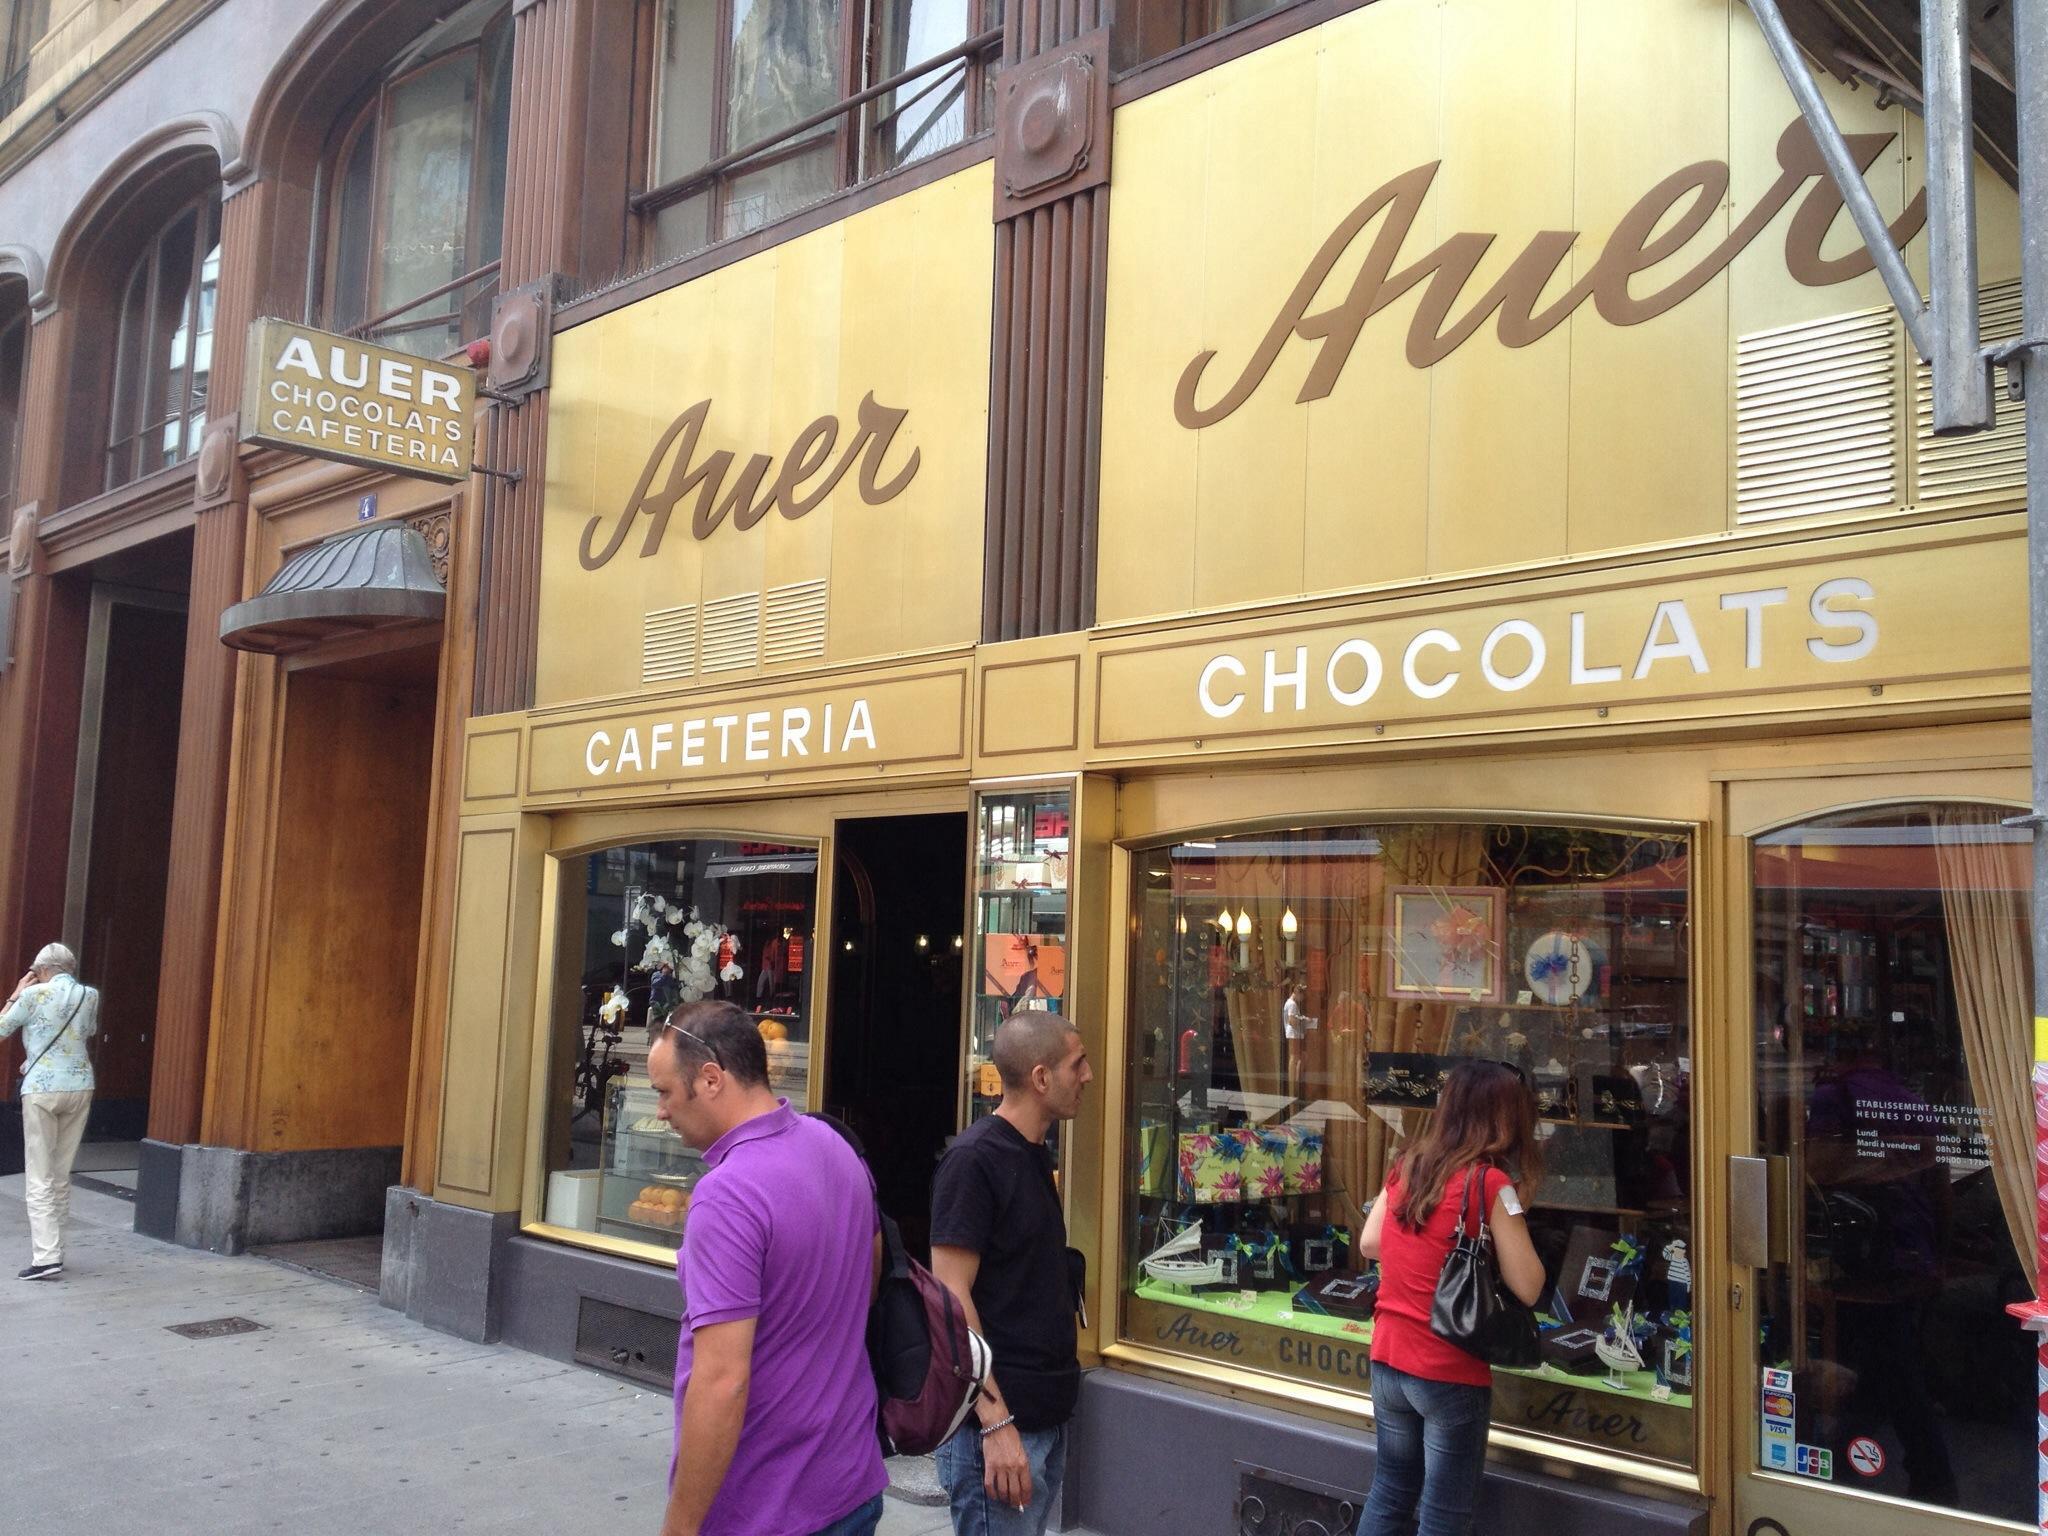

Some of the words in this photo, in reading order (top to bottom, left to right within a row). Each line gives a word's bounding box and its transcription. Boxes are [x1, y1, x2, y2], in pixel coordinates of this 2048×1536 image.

[1174, 113, 1927, 430] Auer
[276, 337, 462, 412] AUER
[270, 380, 461, 441] CHOCOLATS
[272, 409, 459, 468] CAFETERIA
[579, 390, 920, 571] Auer
[361, 498, 369, 518] 4
[1199, 578, 1879, 719] CHOCOLATS
[586, 698, 877, 775] CAFETERIA
[1856, 1100, 1930, 1112] ETABLISSEMENT
[1932, 1105, 1958, 1114] SANS
[1856, 1111, 1899, 1120] HEURES
[1904, 1114, 1994, 1127] D'OUVERTURES
[1856, 1129, 1878, 1137] Lundi
[1935, 1135, 1961, 1144] 10h00
[1969, 1137, 1994, 1146] 18h45
[1856, 1139, 1879, 1148] Mardi
[1886, 1141, 1921, 1151] vendredi
[1935, 1146, 1961, 1154] 08h30
[1969, 1148, 1994, 1156] 18h45
[1857, 1149, 1886, 1158] Samedi
[1935, 1156, 1961, 1165] 09h00
[1156, 1312, 1244, 1356] Auer
[1526, 1390, 1648, 1443] Auer
[1769, 1424, 1788, 1435] VISA
